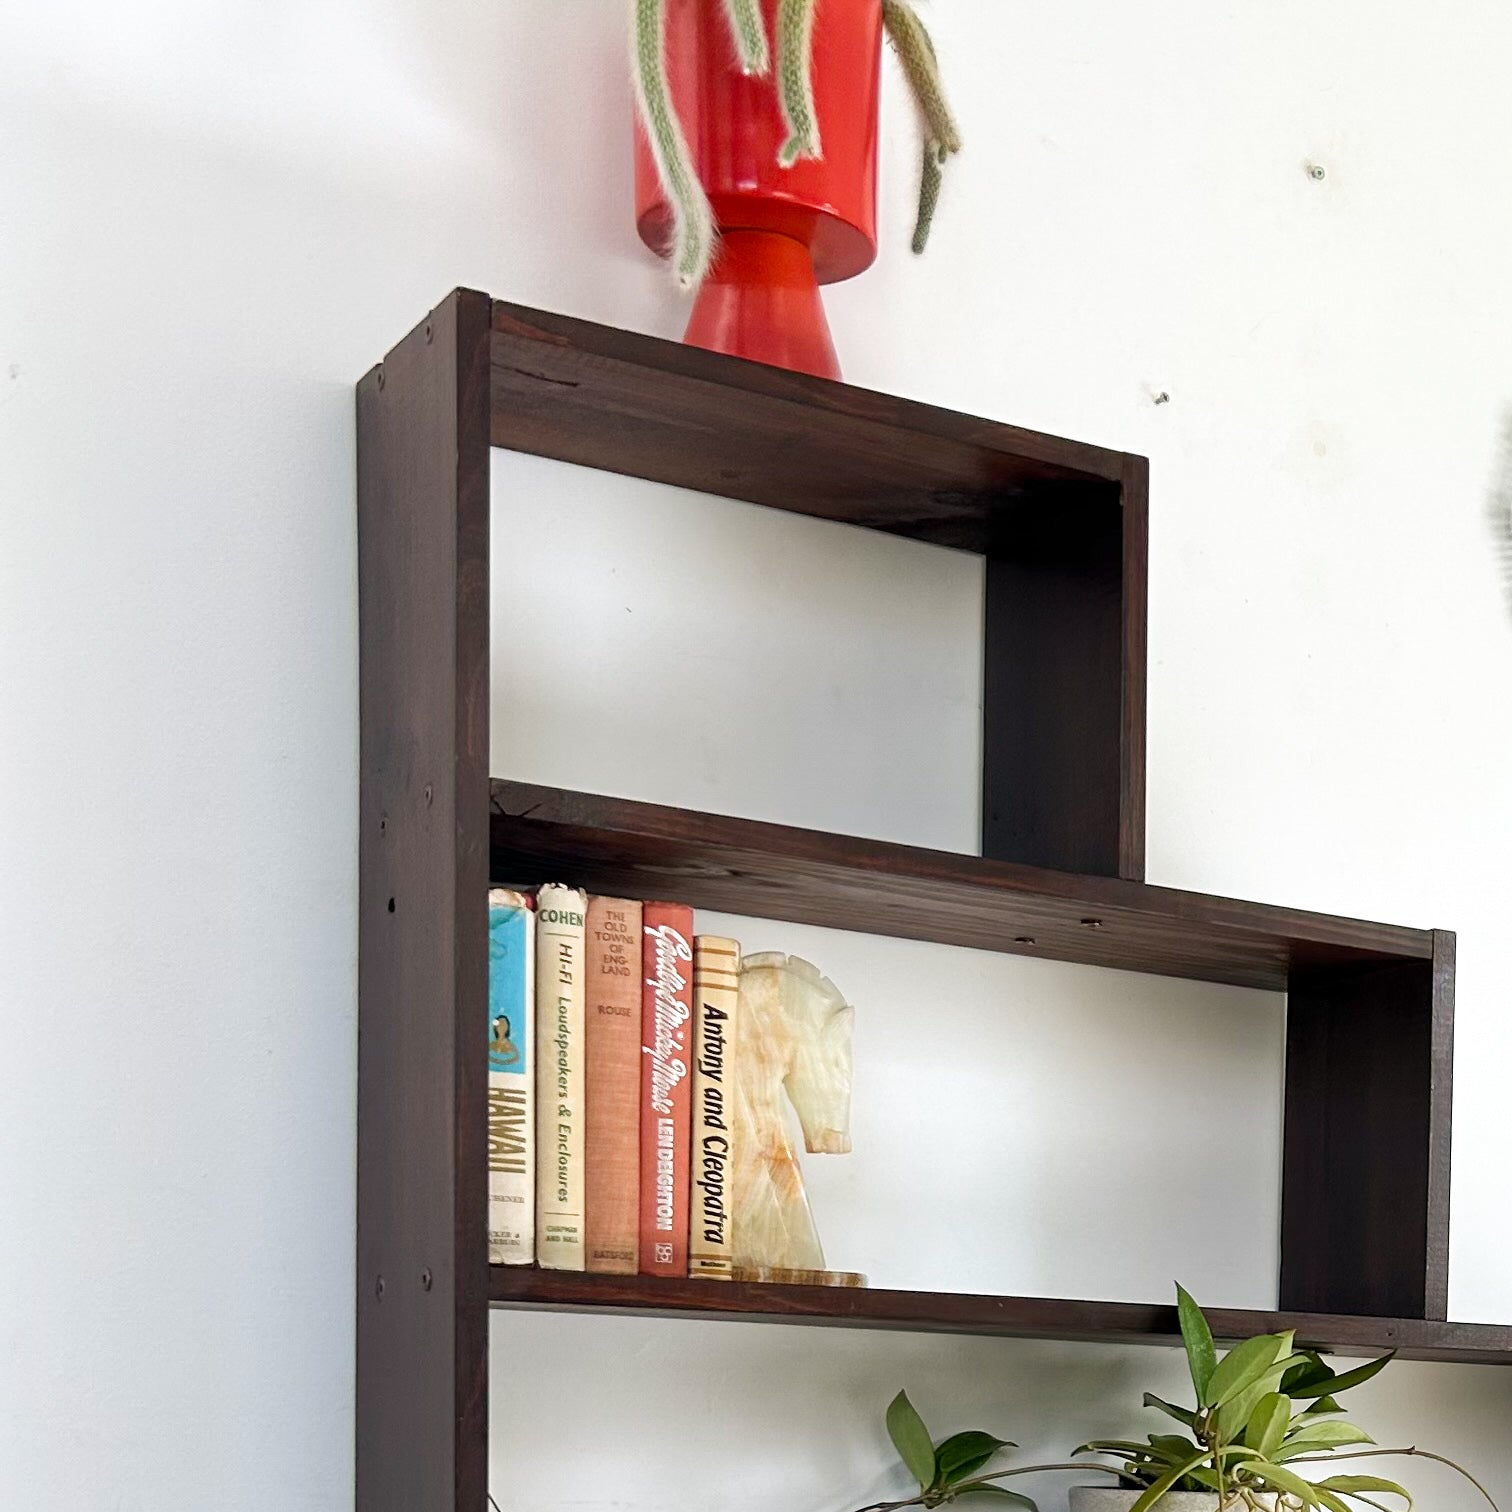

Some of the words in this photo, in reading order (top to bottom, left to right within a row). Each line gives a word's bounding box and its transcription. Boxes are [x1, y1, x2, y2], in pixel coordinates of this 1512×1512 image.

[539, 908, 583, 927] COHEN
[603, 921, 628, 933] OLD
[605, 910, 625, 922] THE
[594, 931, 635, 945] TOWNS
[608, 944, 625, 955] OF
[559, 943, 573, 986] HI-FI
[601, 965, 632, 977] LAND
[596, 1004, 632, 1018] ROUSE
[641, 998, 690, 1062] Mickey
[553, 996, 572, 1099] Loudspeakers
[698, 1003, 729, 1083] Antony
[651, 1057, 687, 1115] Mouse
[487, 1087, 526, 1174] HAWAII
[558, 1103, 572, 1117] &
[703, 1087, 728, 1131] and
[657, 1118, 674, 1148] LEN
[558, 1123, 572, 1203] Enclosures
[656, 1148, 674, 1231] DEIGHTON
[696, 1135, 729, 1245] Cleopatra
